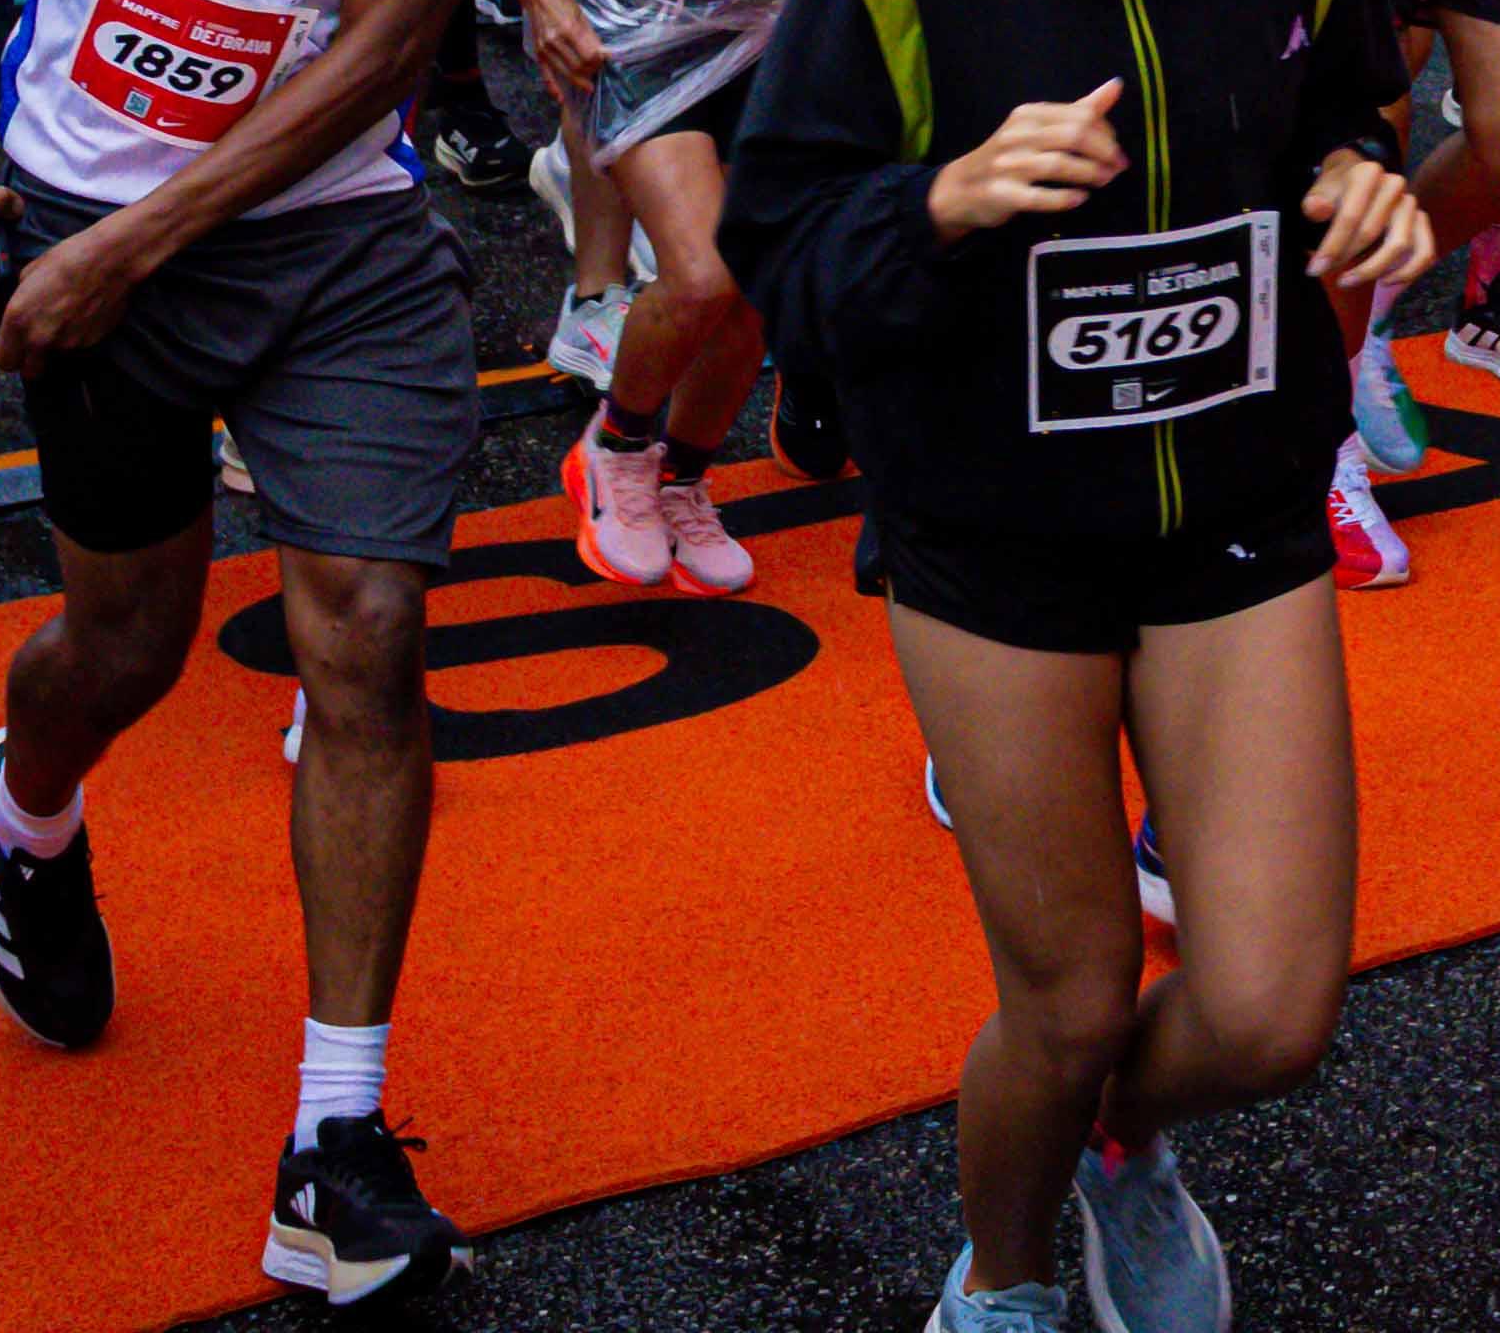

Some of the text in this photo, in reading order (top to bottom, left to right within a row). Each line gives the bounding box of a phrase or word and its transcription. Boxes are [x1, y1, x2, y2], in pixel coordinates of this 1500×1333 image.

[113, 33, 245, 99] 1859
[190, 25, 272, 56] DESBRAVA
[1069, 304, 1223, 365] 5169
